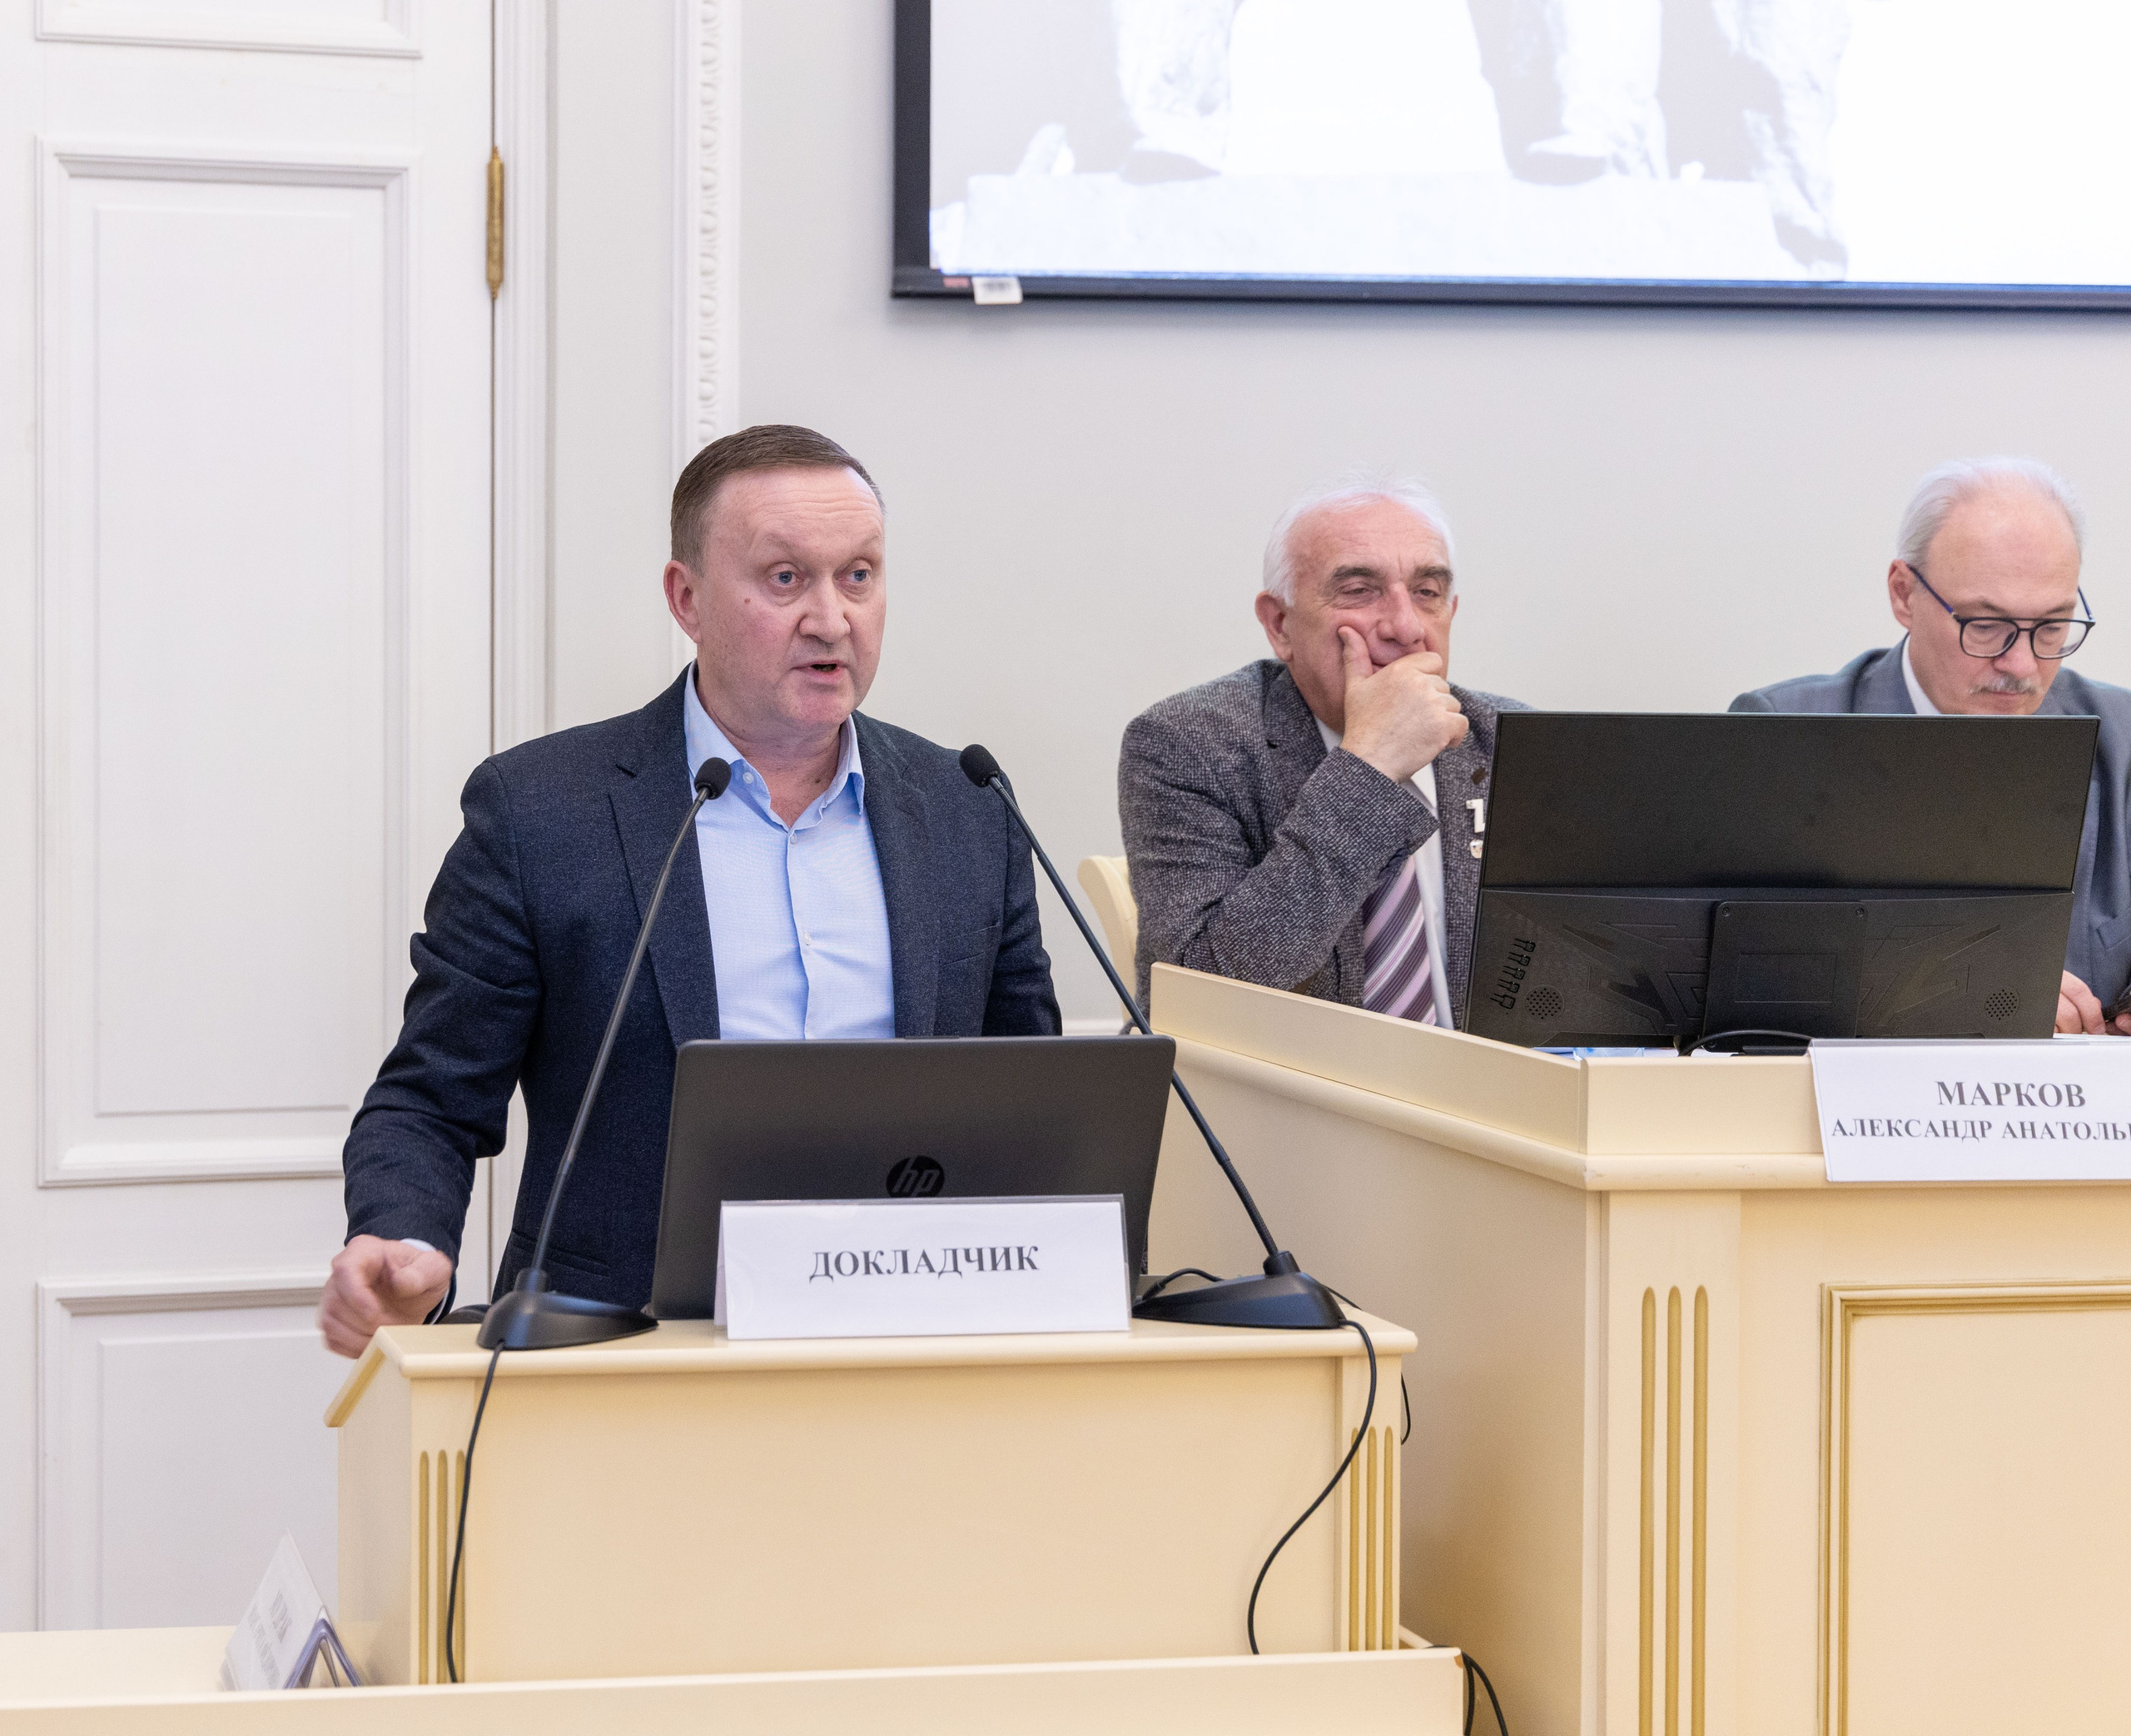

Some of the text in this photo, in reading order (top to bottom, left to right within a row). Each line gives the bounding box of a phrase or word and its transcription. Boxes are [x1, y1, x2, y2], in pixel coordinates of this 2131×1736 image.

[1936, 1081, 2085, 1107] МАРКОВ
[1831, 1118, 1993, 1143] АЛЕКСАНДР
[891, 1157, 940, 1198] hp
[809, 1246, 1038, 1282] ДОКЛАДЧИК
